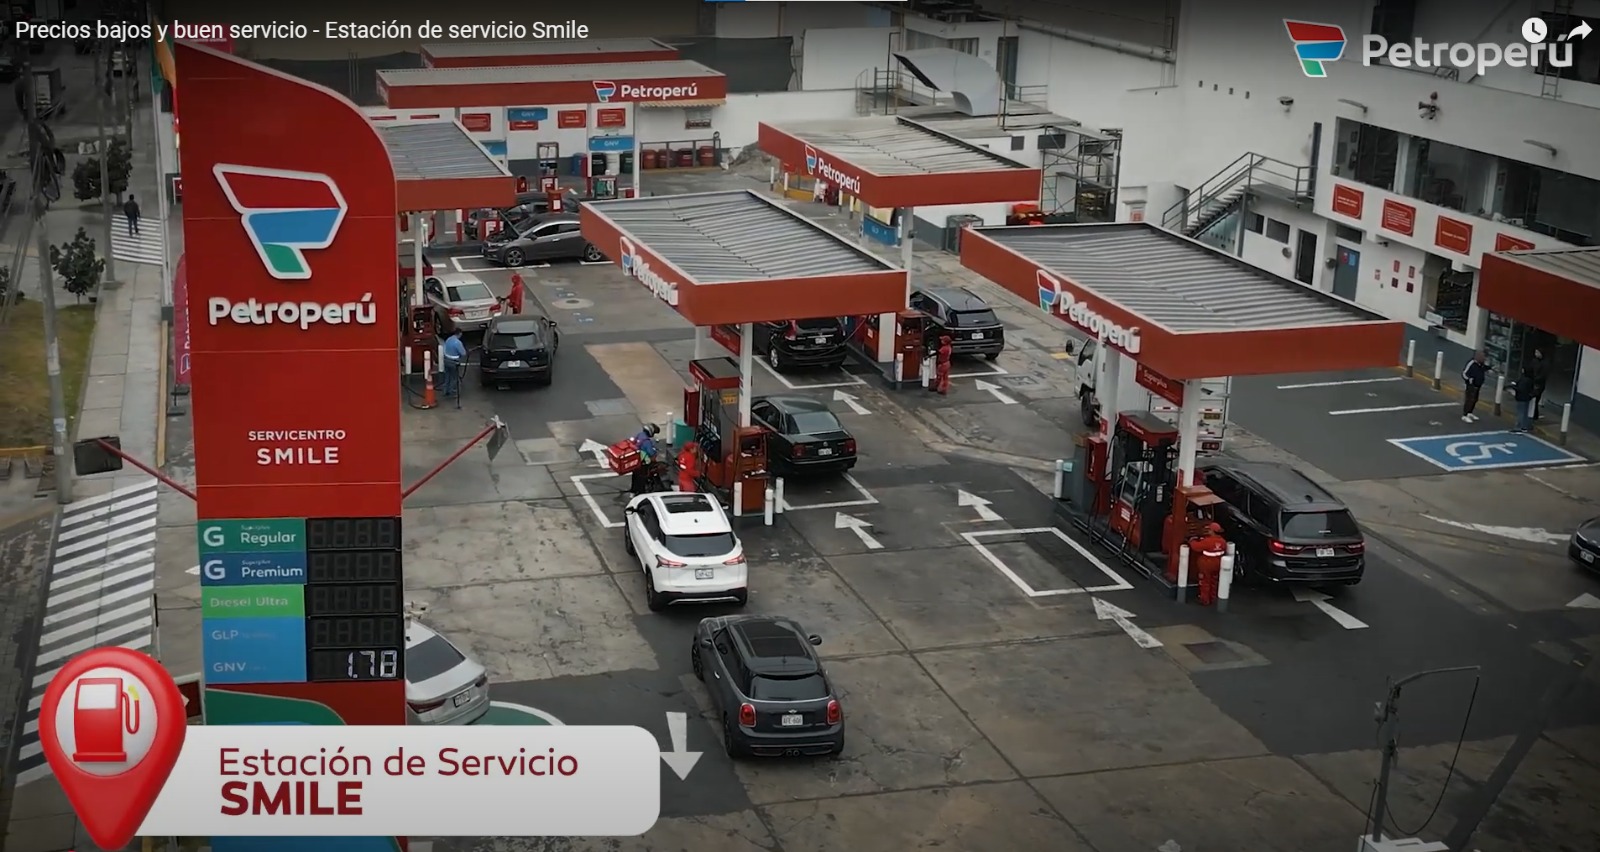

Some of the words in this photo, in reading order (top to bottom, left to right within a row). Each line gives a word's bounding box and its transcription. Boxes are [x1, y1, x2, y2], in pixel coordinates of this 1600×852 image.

[621, 82, 698, 100] Petroperú
[818, 157, 861, 194] Petroperú
[632, 255, 678, 306] Petroperú
[208, 293, 377, 330] Petroperú
[1060, 291, 1140, 354] Petroperú
[248, 429, 346, 441] SERVICENTRO
[257, 446, 340, 465] SMILE
[203, 526, 225, 547] G
[240, 531, 296, 547] Regular
[204, 560, 226, 580] G
[241, 566, 303, 578] Premium
[210, 597, 251, 607] Diesel
[256, 597, 288, 606] Ultra
[212, 630, 239, 640] GLP
[213, 662, 246, 672] GNV
[347, 650, 397, 678] 1.78
